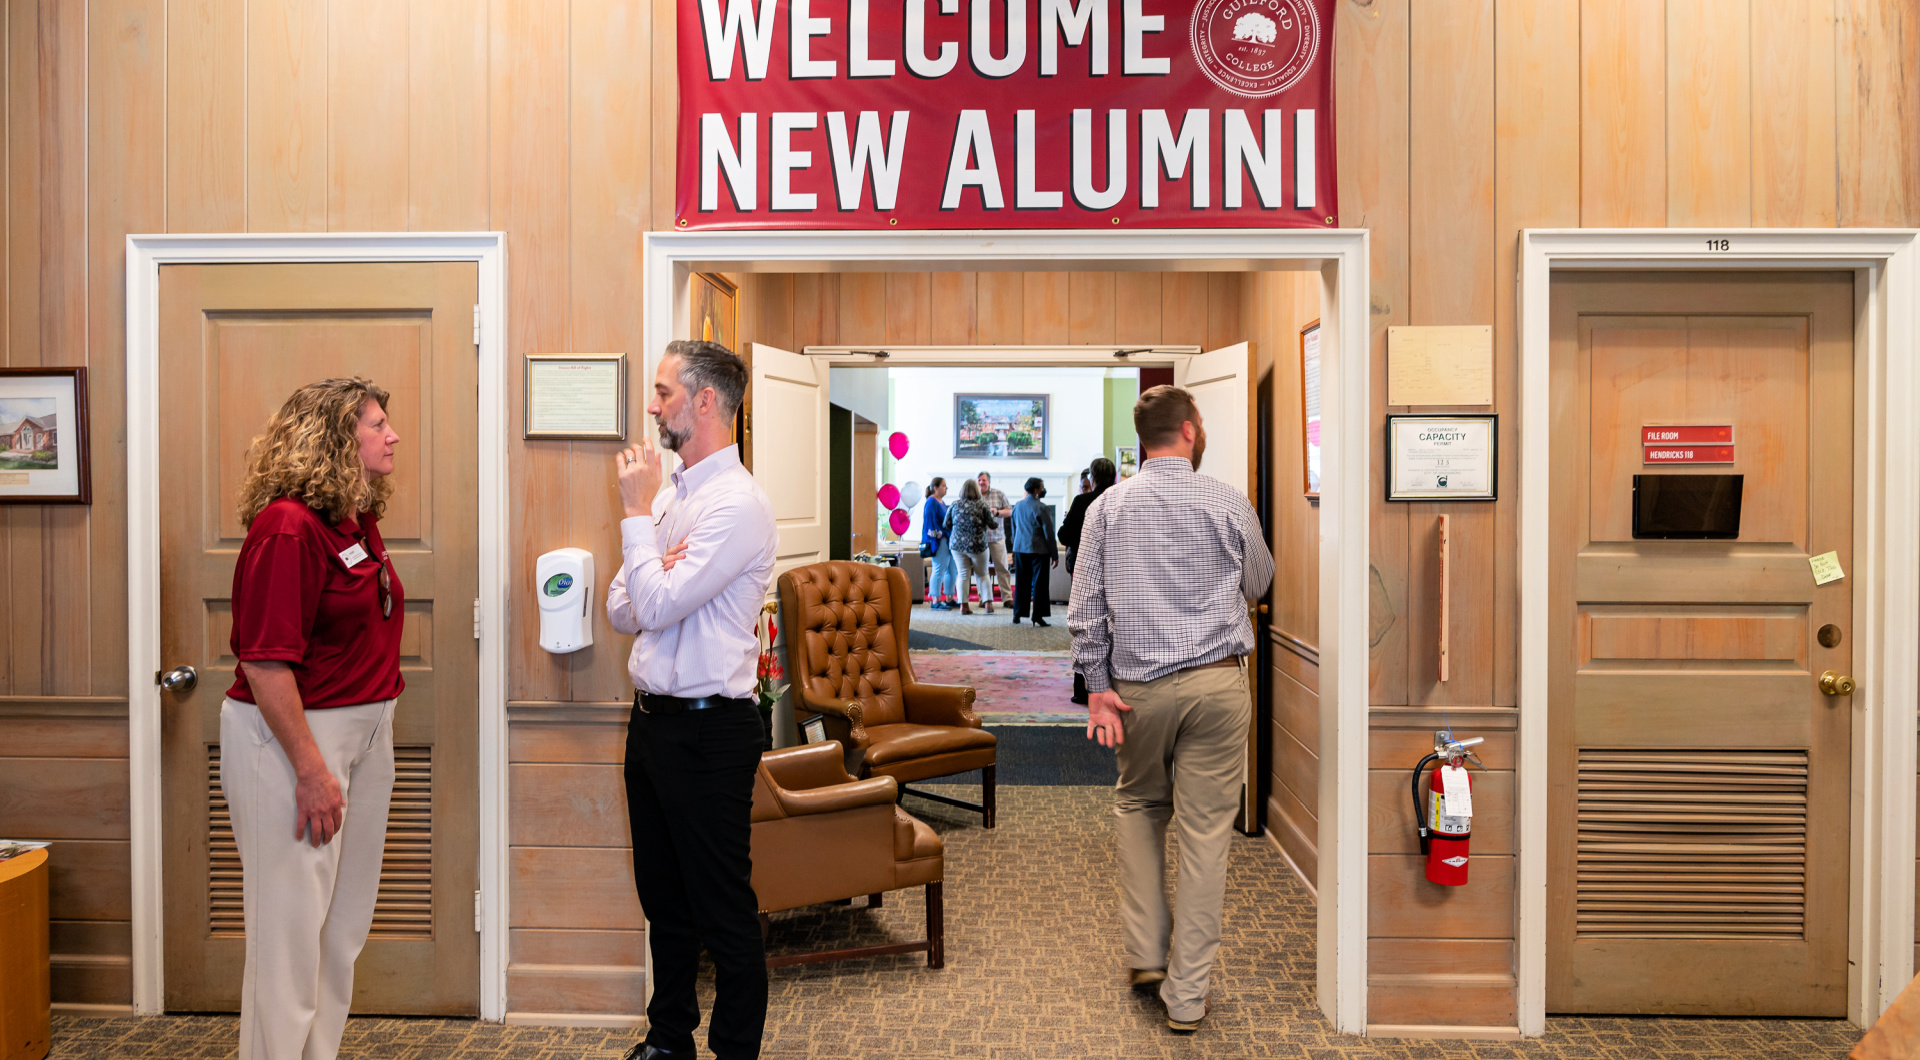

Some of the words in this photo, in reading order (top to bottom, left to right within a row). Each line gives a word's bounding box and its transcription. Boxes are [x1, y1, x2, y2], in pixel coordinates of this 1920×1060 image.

[1202, 0, 1217, 22] JUSTIC
[698, 0, 1170, 81] WELCOME
[1200, 30, 1214, 65] INTEGRITY
[1299, 25, 1310, 60] DIVERSITY
[1225, 52, 1275, 72] COLLEGE
[1250, 47, 1266, 57] 1837
[1217, 69, 1258, 89] EXCELLENCE
[1267, 65, 1297, 87] EQUALITY
[698, 110, 910, 213] NEW
[938, 108, 1316, 211] ALUMNI
[1706, 239, 1730, 251] 118
[1418, 433, 1467, 441] CAPACITY
[1647, 431, 1660, 440] FILE
[1661, 431, 1679, 440] ROOM
[1650, 450, 1683, 459] HENDRICKS
[1684, 450, 1694, 459] 118
